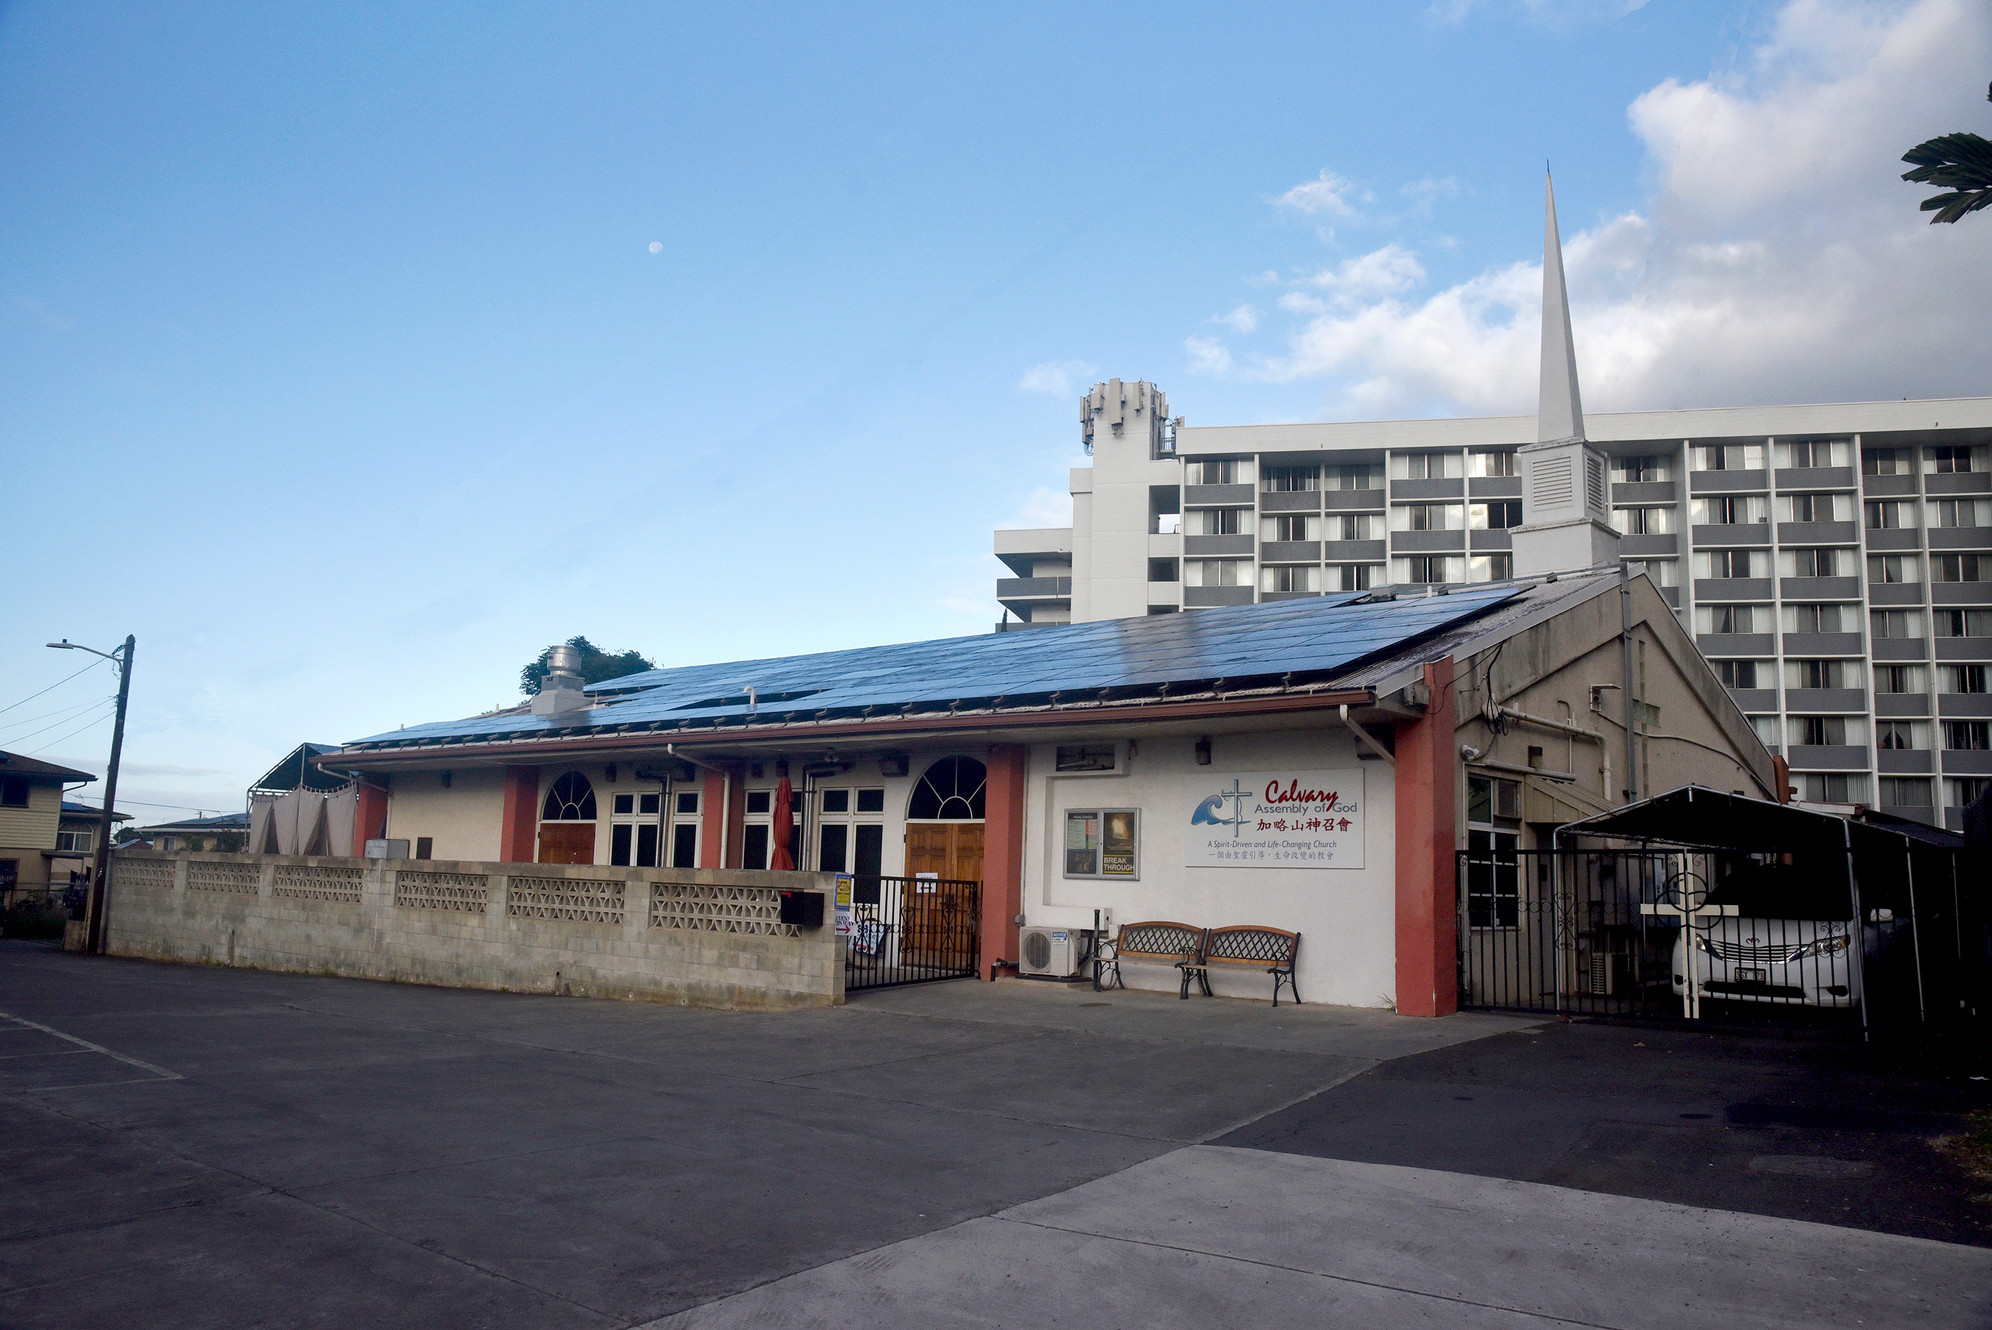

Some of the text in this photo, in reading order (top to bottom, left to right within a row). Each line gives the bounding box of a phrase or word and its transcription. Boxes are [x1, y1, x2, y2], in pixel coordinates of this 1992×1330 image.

[1265, 778, 1339, 812] Calvary
[1254, 802, 1358, 816] Assembly of God
[1256, 817, 1353, 832] 加略山神召會
[1207, 840, 1337, 850] A Spirit-Driven and Life-Changing Church
